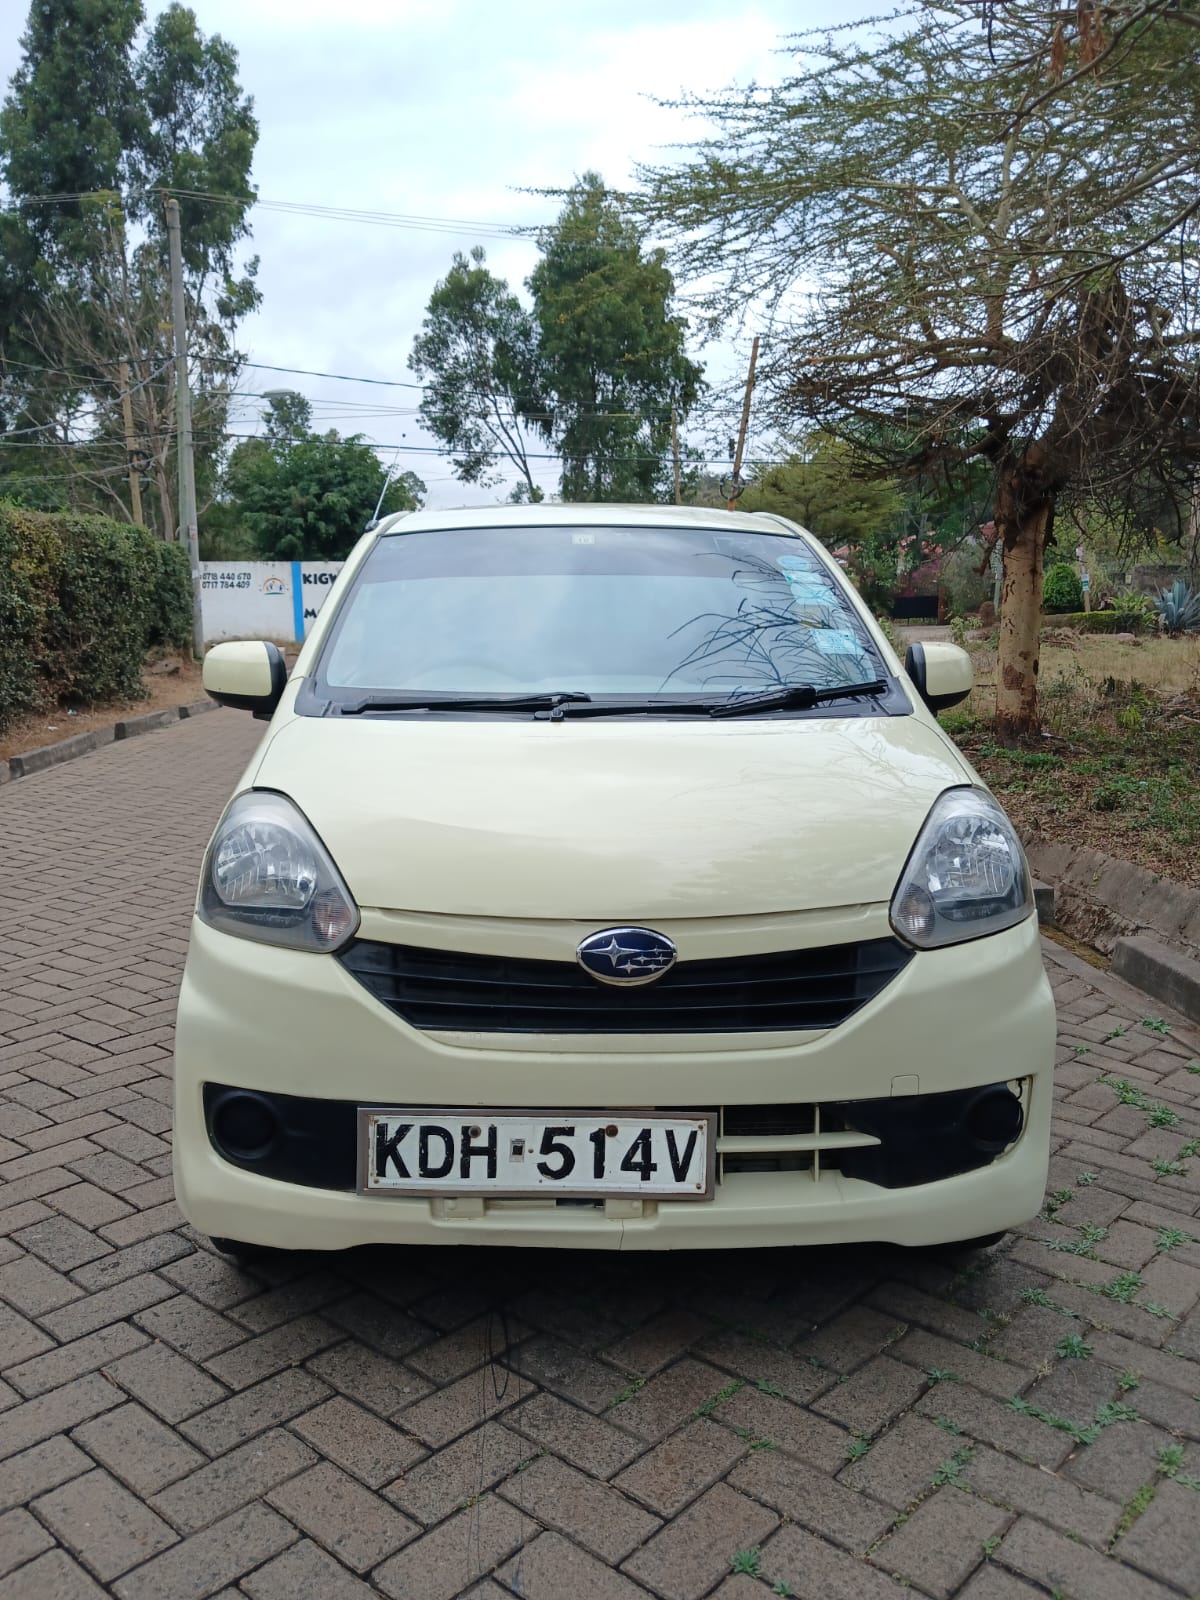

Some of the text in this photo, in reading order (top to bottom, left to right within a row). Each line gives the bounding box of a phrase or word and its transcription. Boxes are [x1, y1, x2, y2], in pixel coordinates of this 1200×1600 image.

[220, 573, 235, 581] 440
[237, 573, 252, 581] 670
[202, 581, 250, 589] 0717 784 409
[376, 1123, 698, 1183] KDH 514V
